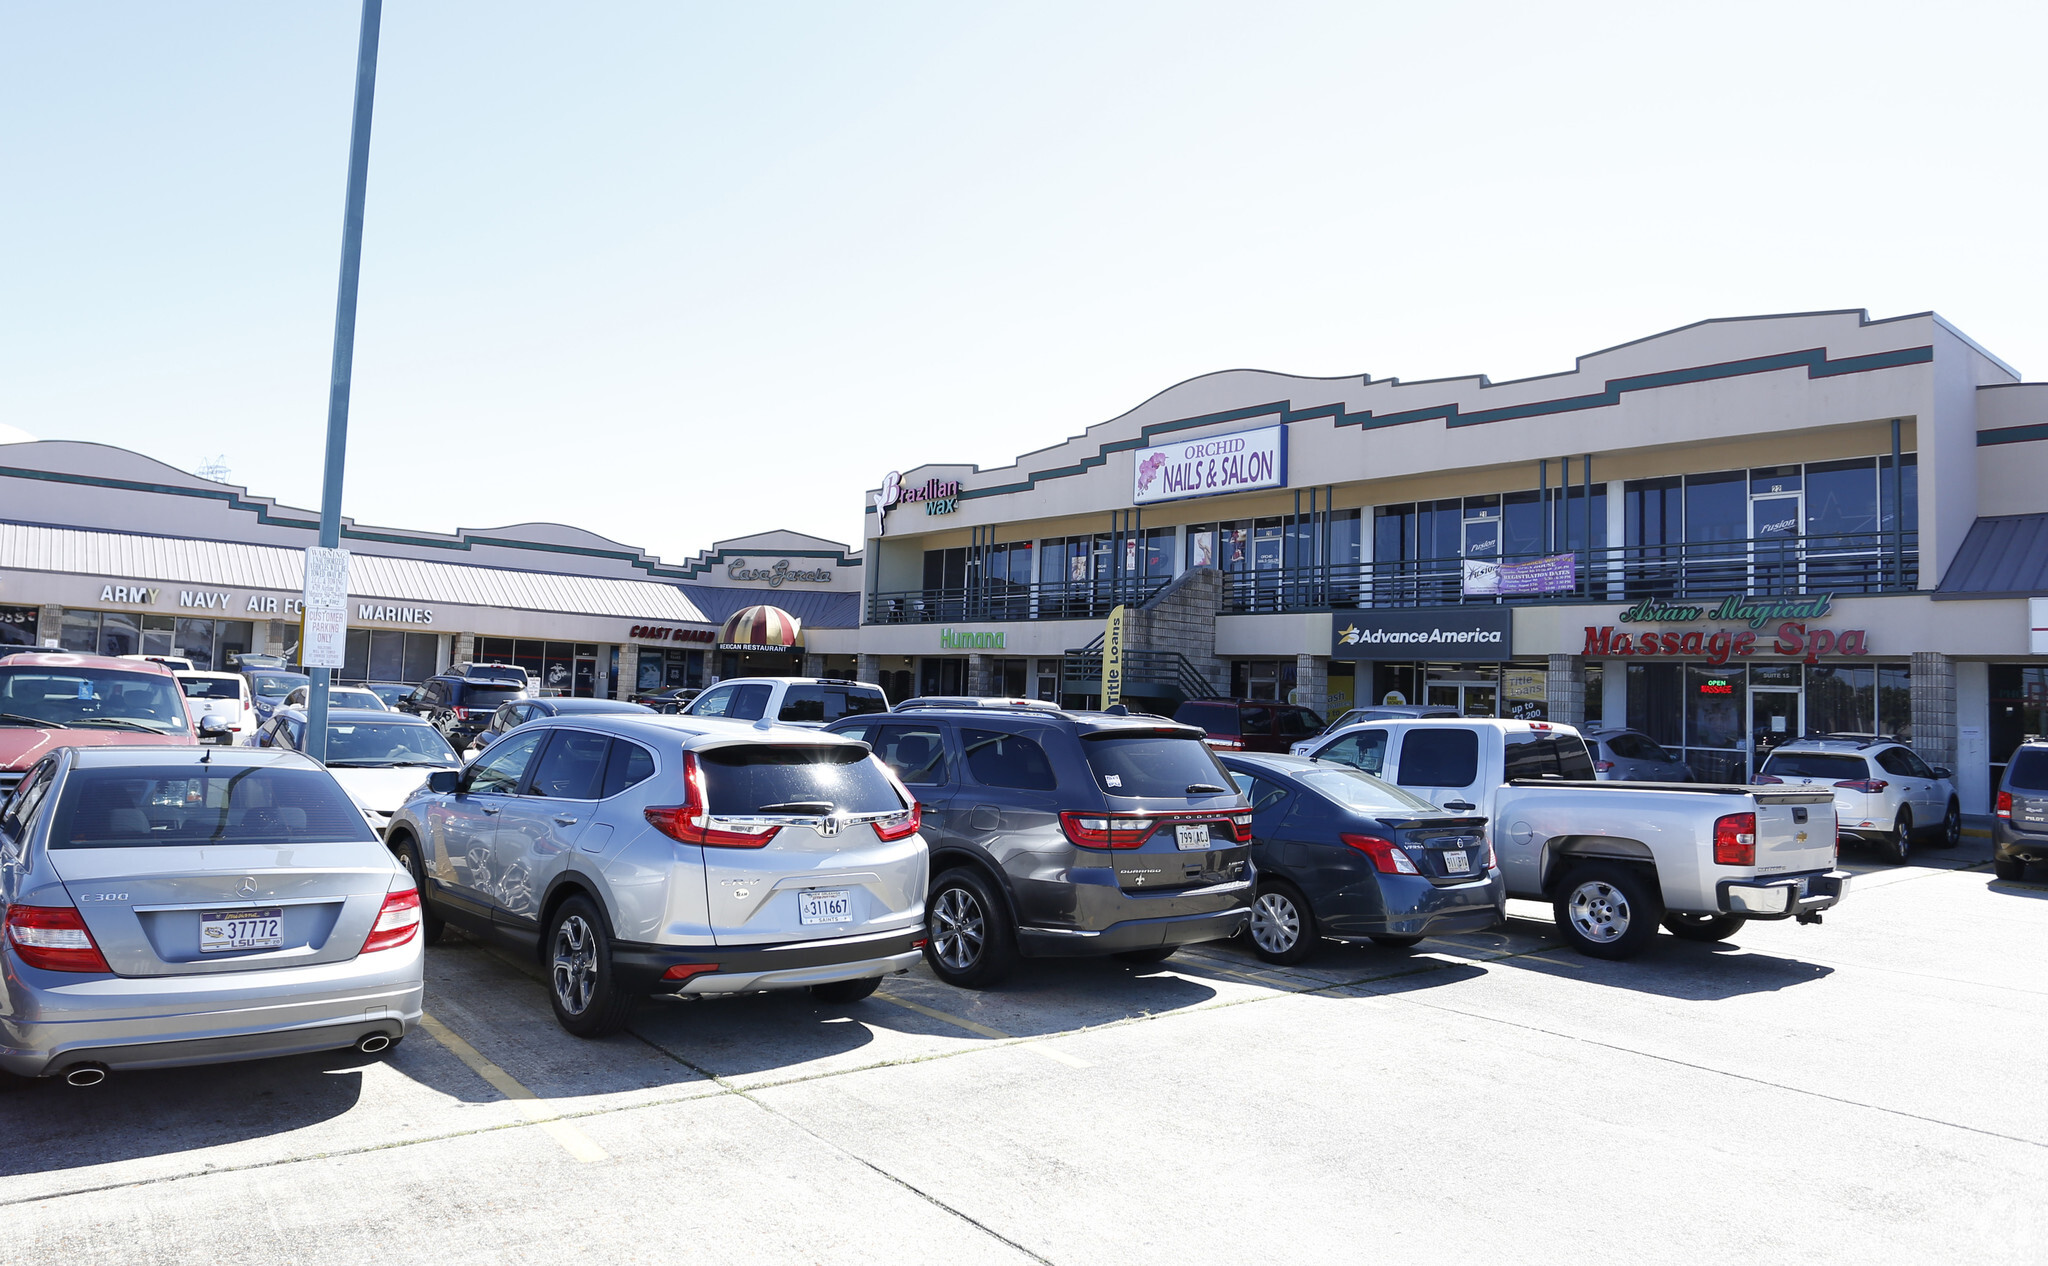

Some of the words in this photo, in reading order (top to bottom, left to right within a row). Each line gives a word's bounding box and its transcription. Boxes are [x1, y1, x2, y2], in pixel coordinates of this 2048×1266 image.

[1184, 438, 1245, 460] ORCHID
[1164, 460, 1203, 493] NAILS
[1206, 458, 1217, 488] &
[1222, 450, 1273, 486] SALON
[884, 470, 958, 506] Brazilian
[925, 498, 956, 516] wax
[1760, 519, 1796, 534] Fusion
[1470, 540, 1496, 552] Fusion
[728, 558, 770, 580] Casa
[769, 559, 832, 588] Garcia
[100, 584, 160, 604] ARMY
[180, 590, 230, 609] NAVY
[247, 596, 278, 612] AIR
[309, 610, 344, 622] CUSTOMER
[358, 604, 433, 624] MARINES
[1620, 596, 1704, 622] Asian
[1708, 592, 1834, 629] Magical
[312, 622, 340, 633] PARKING
[630, 624, 672, 639] COAST
[672, 628, 715, 643] GUARD
[317, 633, 333, 643] ONLY
[940, 628, 1007, 649] Humana
[1110, 616, 1120, 664] Loans
[1581, 625, 1758, 665] Massage
[1774, 622, 1868, 664] Spa
[1108, 669, 1119, 705] Title
[1510, 676, 1532, 685] Title
[1328, 692, 1345, 702] ash
[1511, 684, 1542, 696] Loans
[1700, 685, 1732, 693] MASSAGE
[1512, 705, 1522, 714] up
[1180, 832, 1192, 844] 799
[1196, 832, 1208, 843] ACJ
[95, 893, 129, 901] 300
[810, 900, 847, 915] 311667
[228, 920, 278, 939] 37772
[231, 939, 255, 947] LSU
